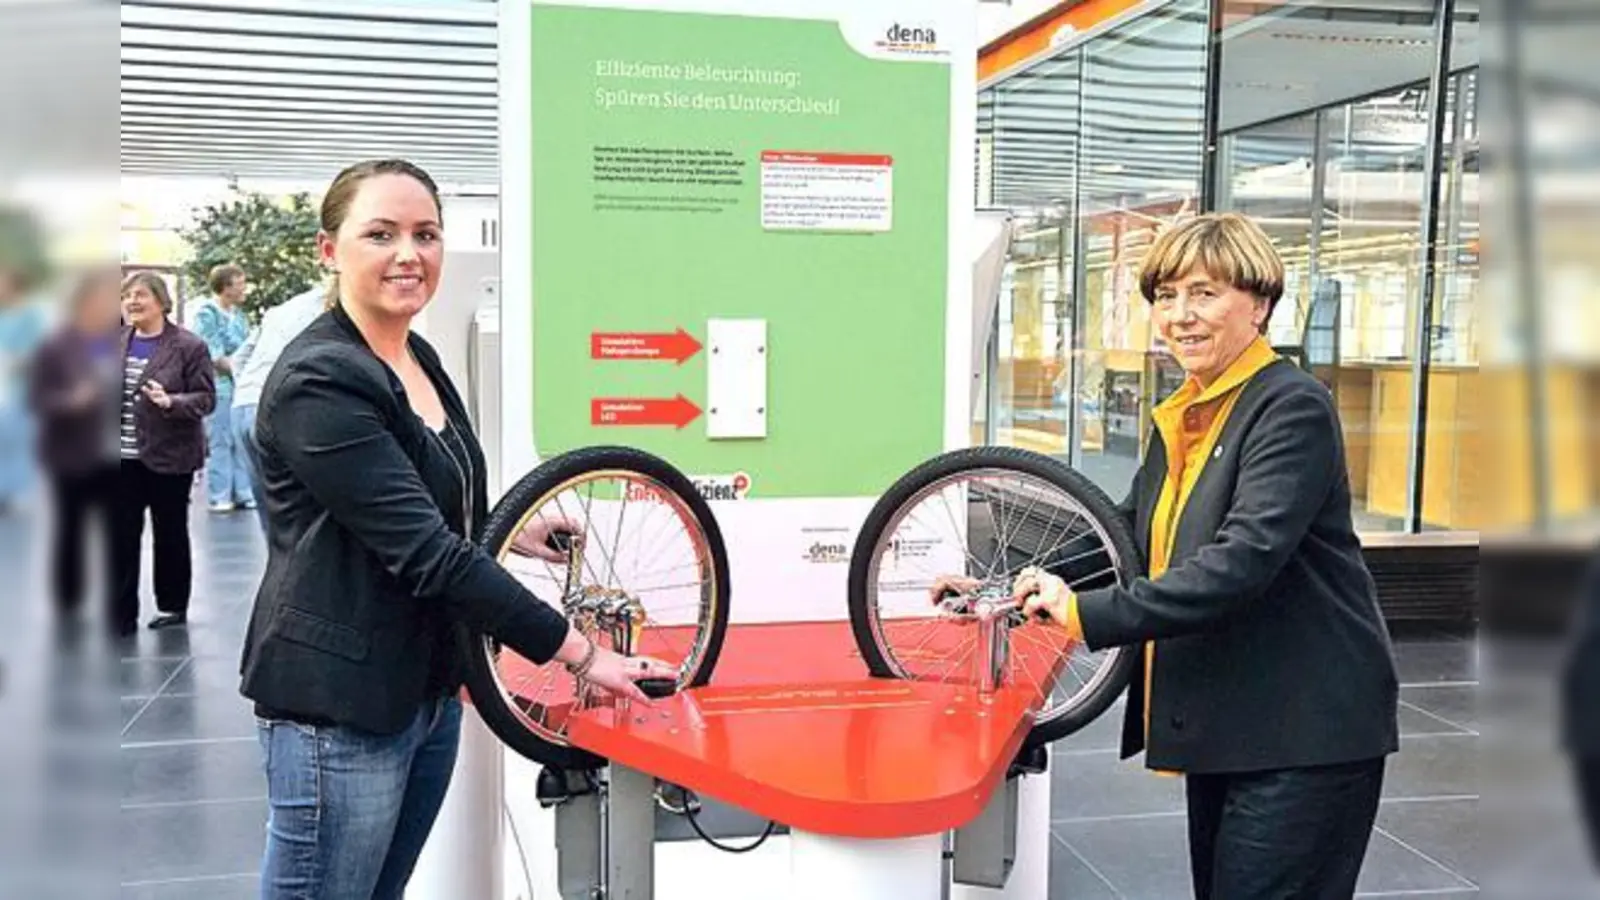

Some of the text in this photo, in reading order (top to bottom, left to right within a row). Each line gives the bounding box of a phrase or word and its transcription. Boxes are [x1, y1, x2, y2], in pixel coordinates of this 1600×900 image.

[886, 22, 937, 44] dena
[596, 59, 801, 89] Effiziente Beleuchtung:
[595, 87, 840, 116] Spüren Sie den Unterschied!
[808, 541, 847, 556] dena
